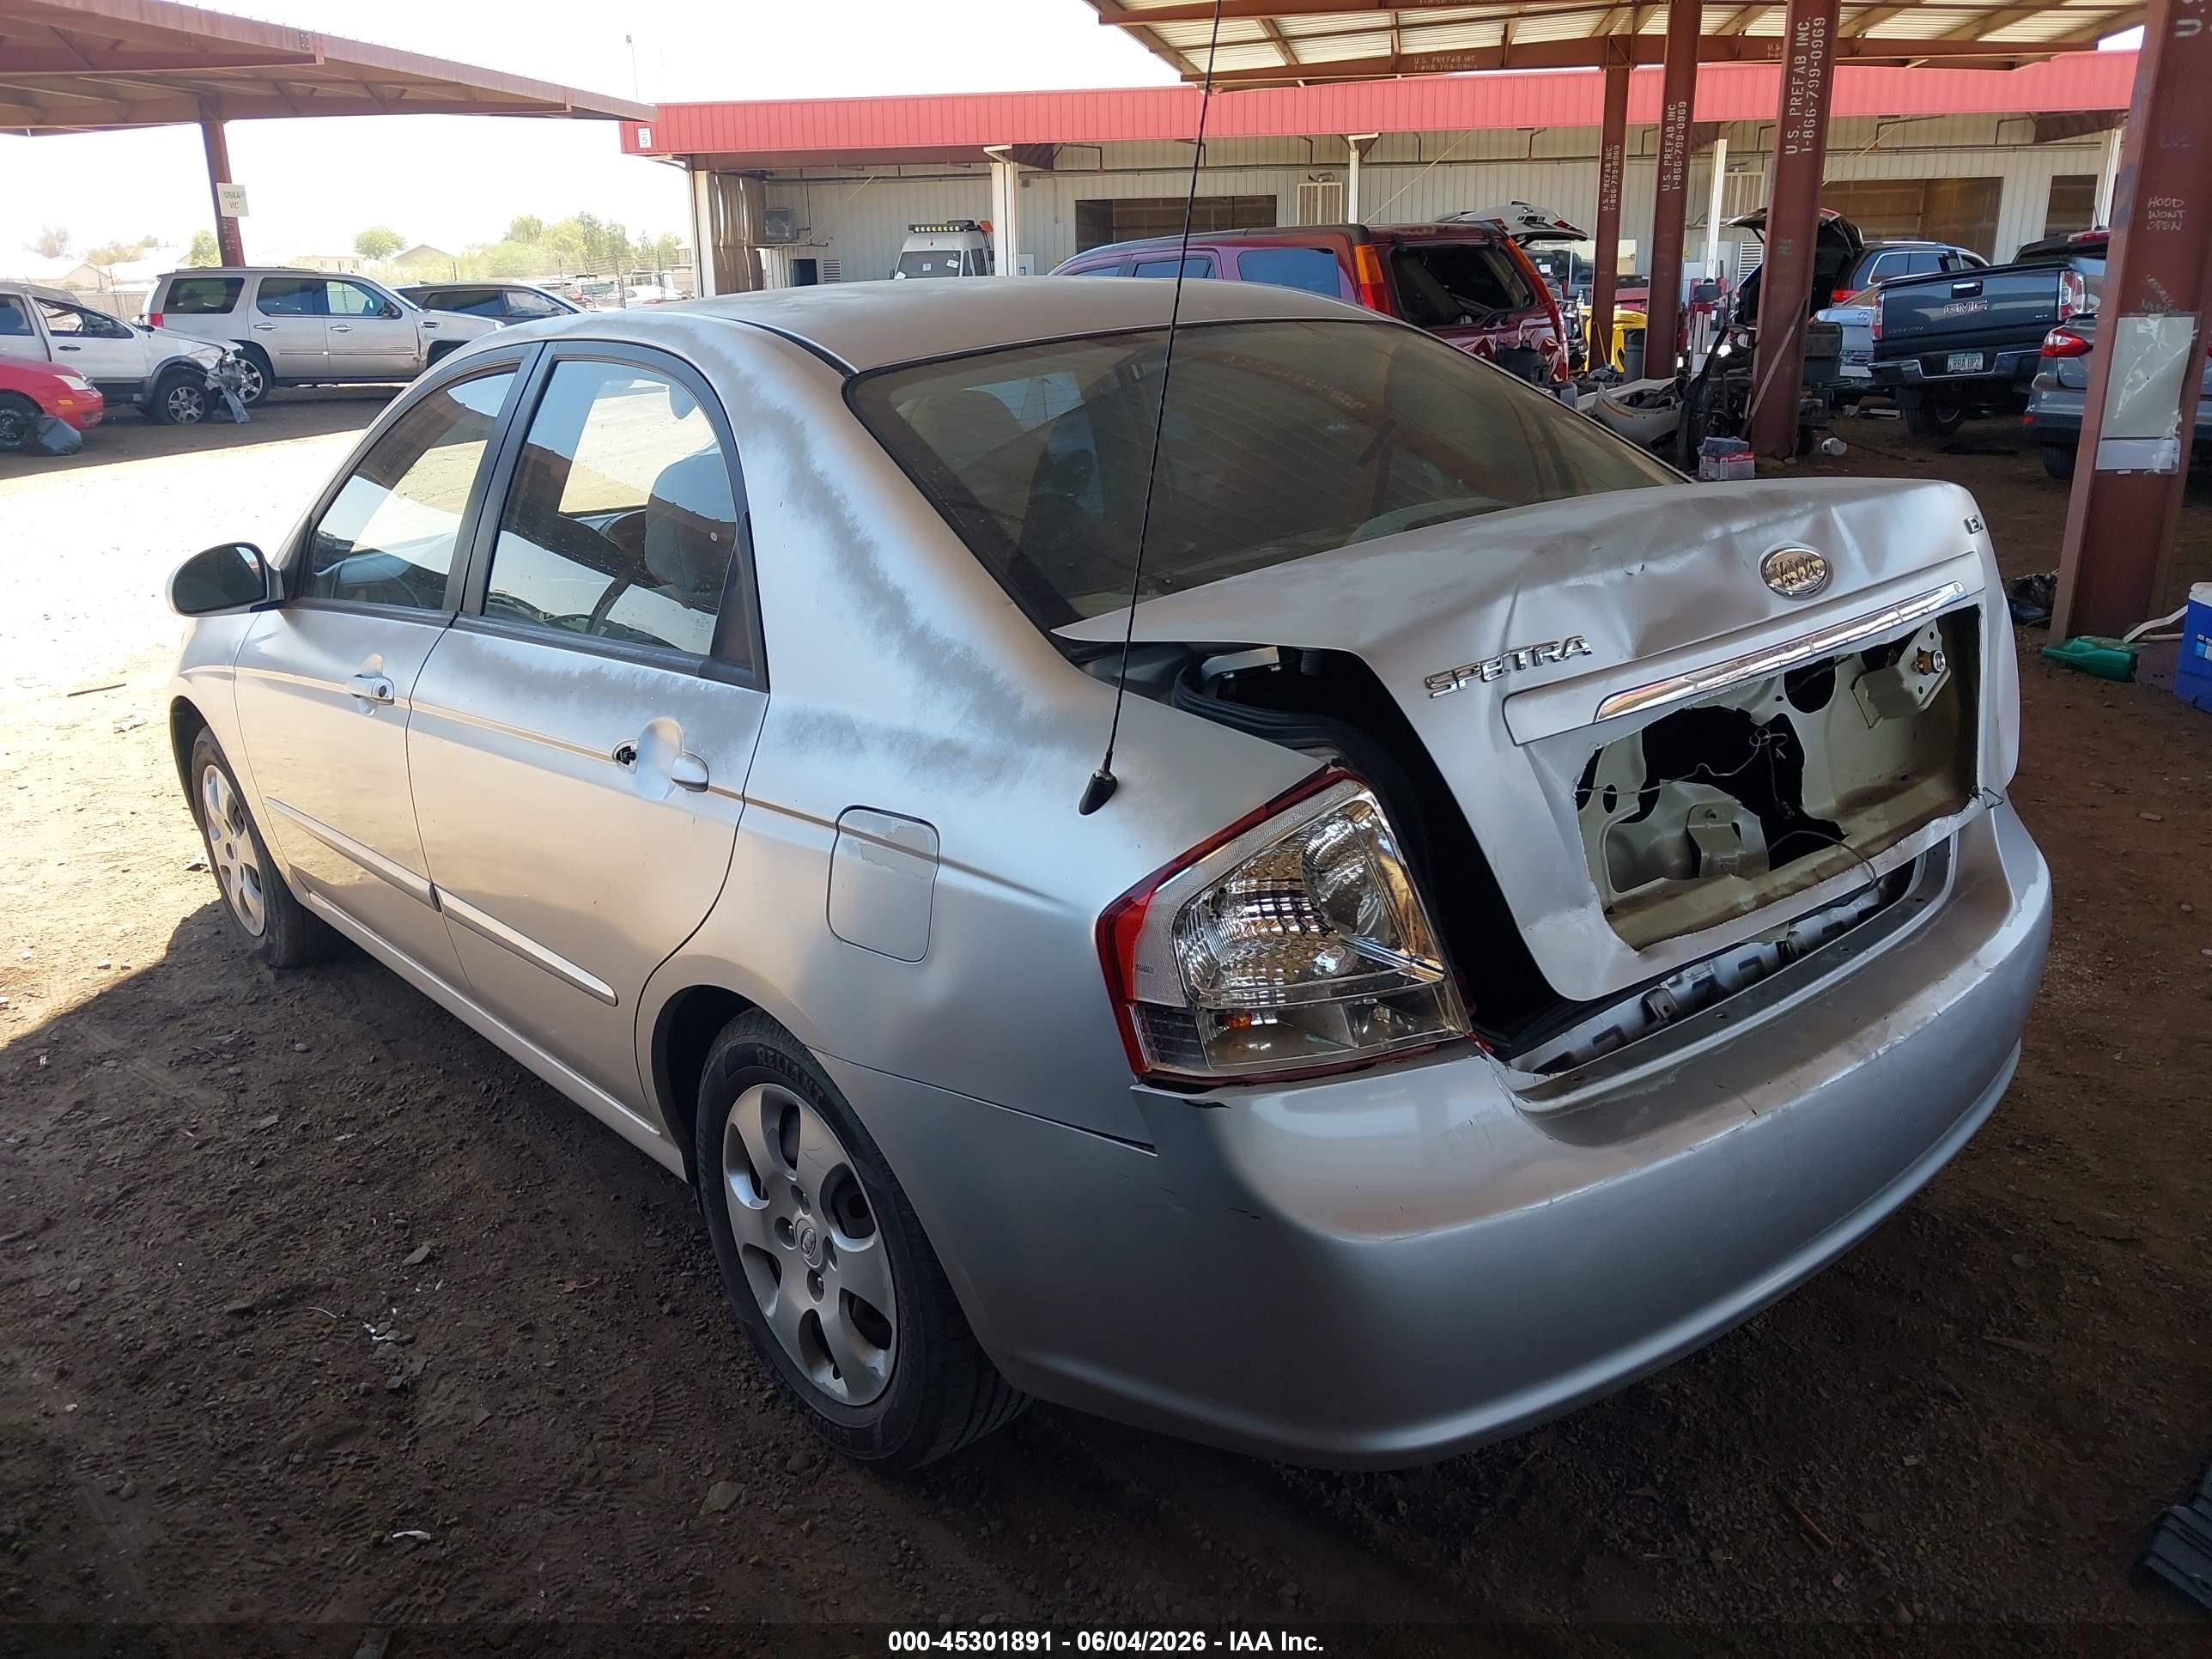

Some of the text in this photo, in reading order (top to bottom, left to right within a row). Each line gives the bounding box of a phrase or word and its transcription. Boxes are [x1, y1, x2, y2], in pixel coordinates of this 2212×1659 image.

[1784, 16, 1811, 155] U.S. PREFAB INC.
[1801, 17, 1826, 152] 1-866-799-0969
[1663, 125, 1675, 166] PREFAB
[1603, 162, 1612, 193] PREFAB
[2148, 197, 2185, 208] HOOD
[2148, 210, 2186, 219] WONT
[2146, 220, 2182, 232] OPEN
[1944, 300, 1988, 315] GMC
[1767, 554, 1824, 590] KIA
